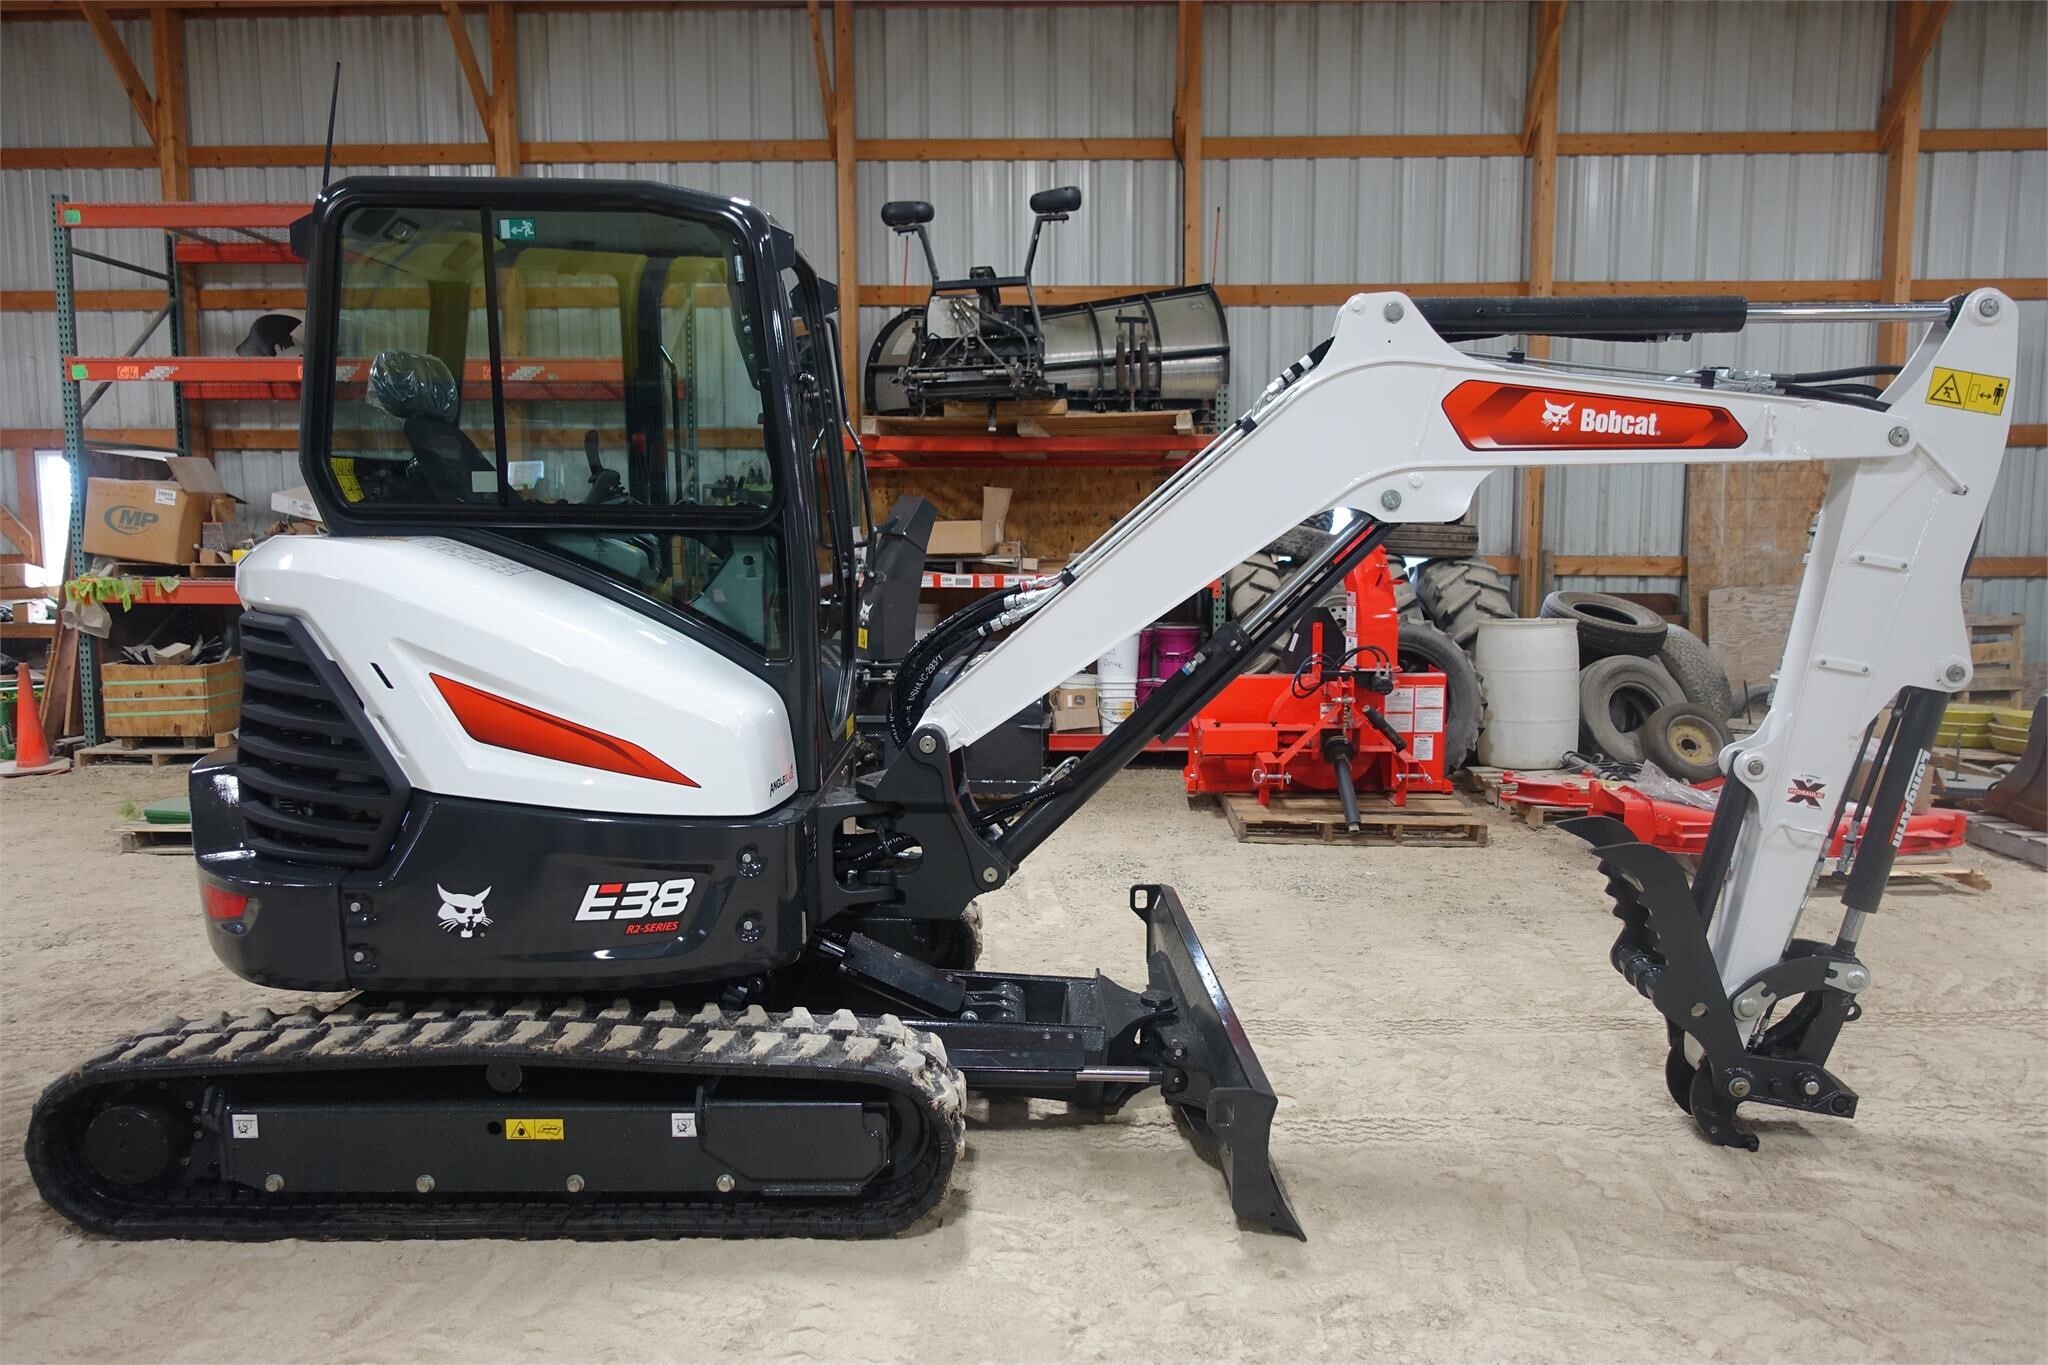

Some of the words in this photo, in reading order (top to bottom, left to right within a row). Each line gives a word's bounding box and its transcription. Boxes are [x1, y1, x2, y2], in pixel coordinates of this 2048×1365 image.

[1580, 408, 1658, 436] Bobcat
[575, 878, 695, 920] E38
[626, 921, 679, 934] R2-SERIES
